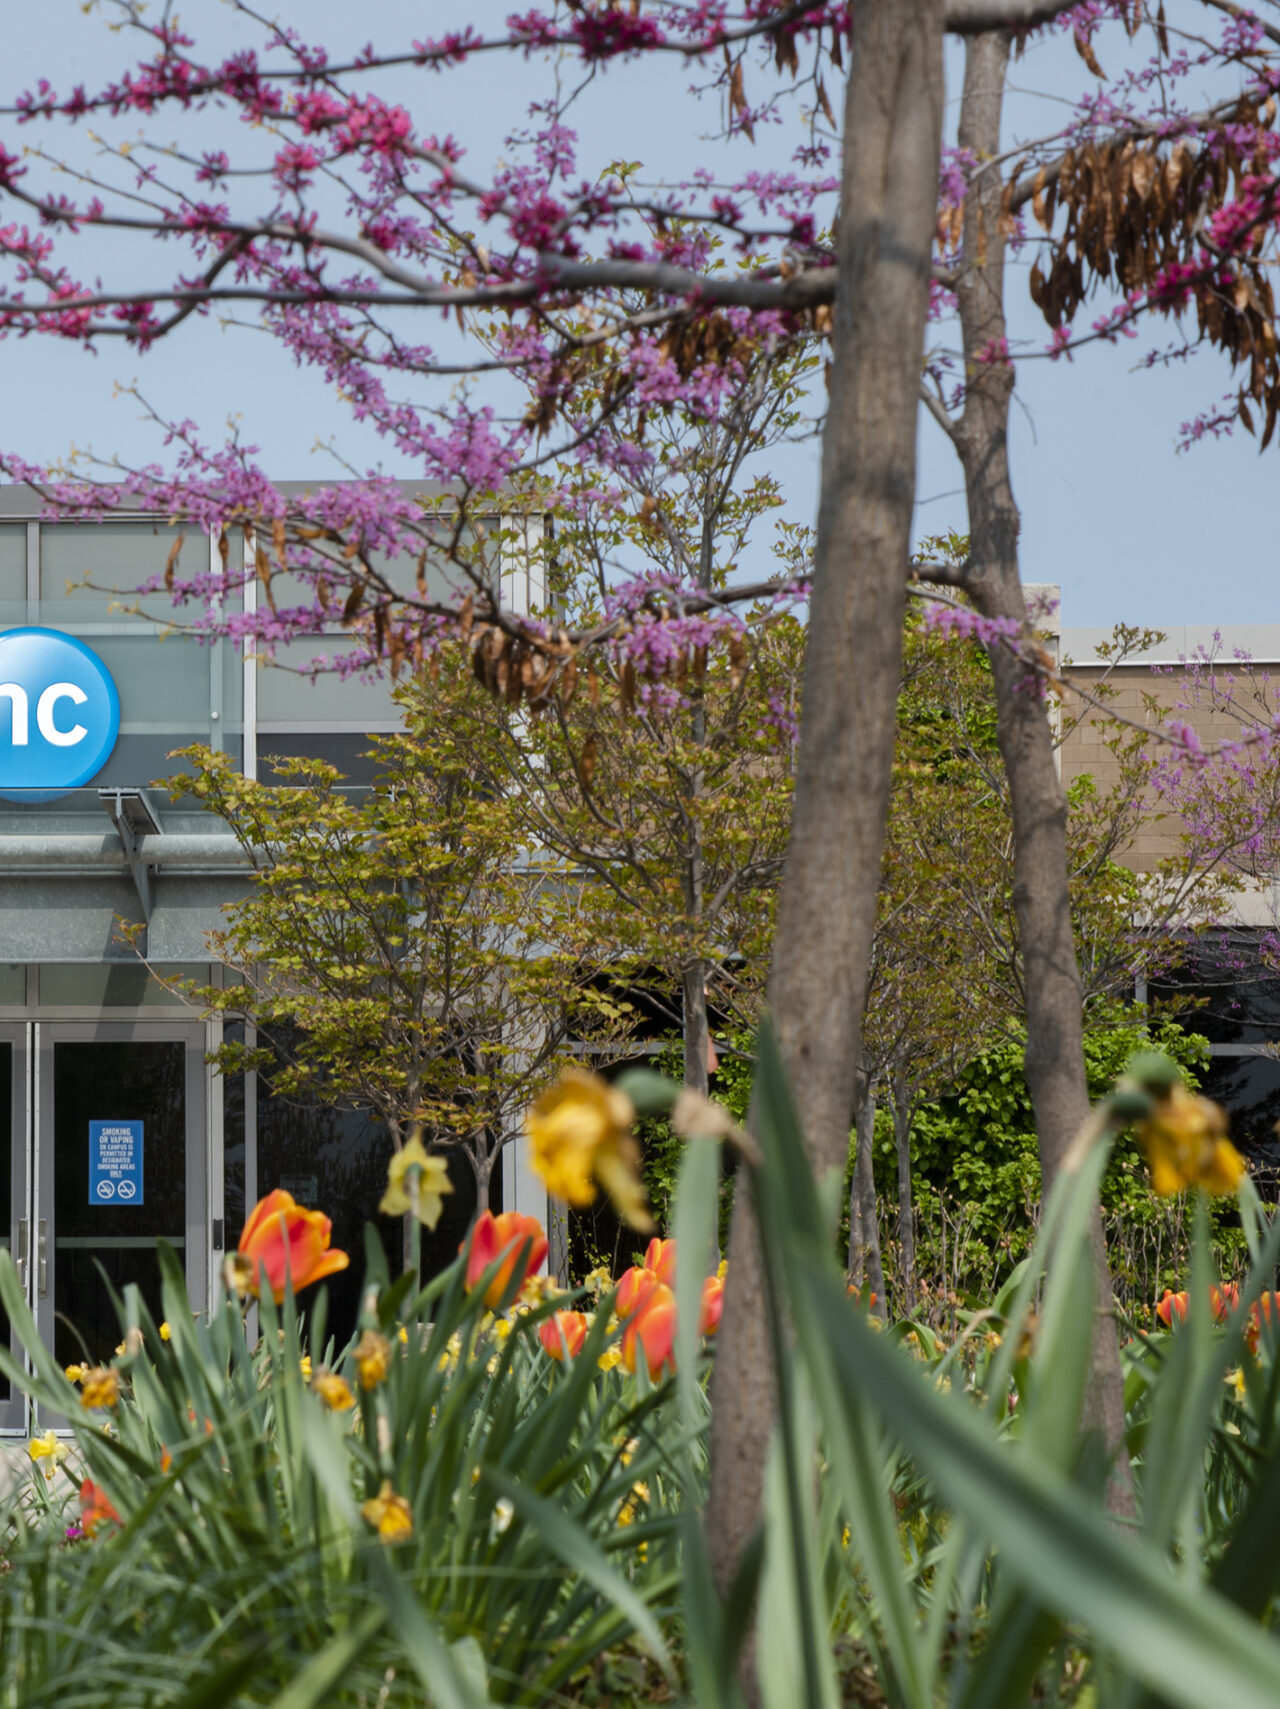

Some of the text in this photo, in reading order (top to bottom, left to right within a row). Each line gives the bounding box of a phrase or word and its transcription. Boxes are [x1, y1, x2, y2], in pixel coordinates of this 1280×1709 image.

[102, 1127, 130, 1136] SMOKING
[99, 1136, 133, 1144] OR VAPING
